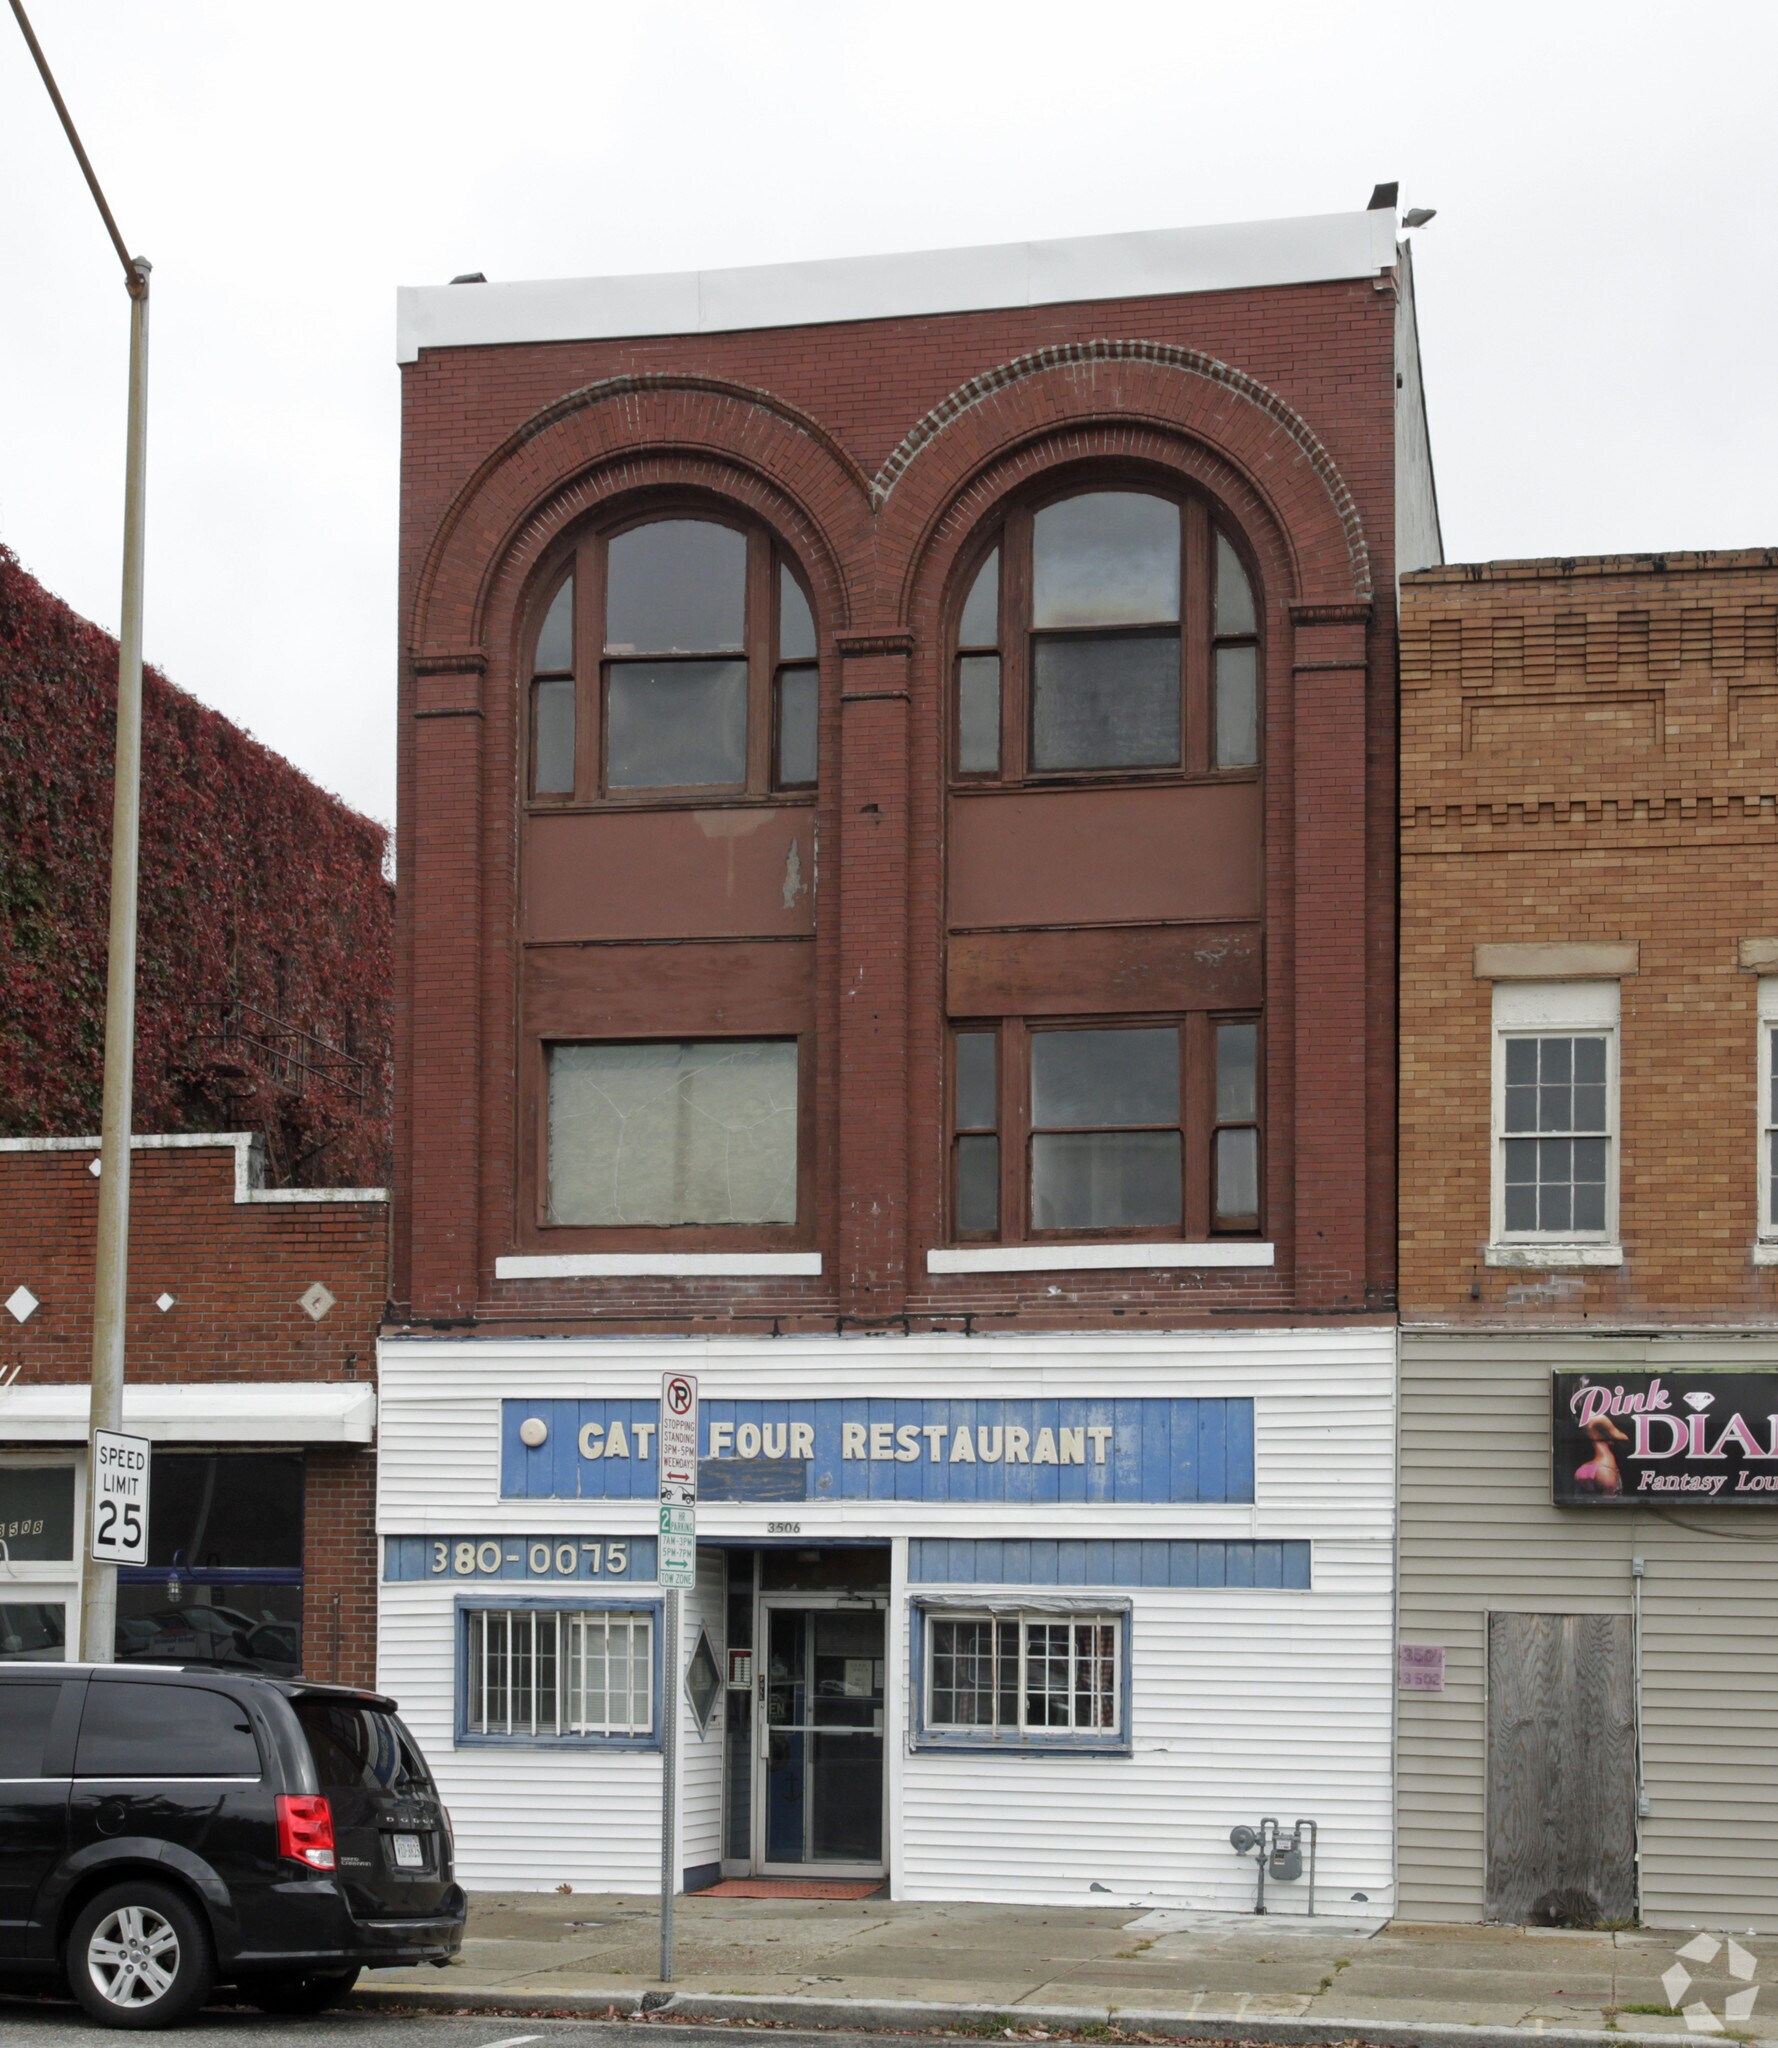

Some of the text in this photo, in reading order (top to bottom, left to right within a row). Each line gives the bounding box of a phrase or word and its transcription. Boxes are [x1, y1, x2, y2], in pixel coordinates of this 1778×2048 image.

[1570, 1378, 1672, 1427] Pink
[664, 1418, 695, 1431] STOPPING
[664, 1431, 695, 1444] STANDING
[1627, 1412, 1778, 1459] DIA
[578, 1421, 1113, 1465] GAT FOUR RESTAURANT
[664, 1444, 694, 1457] 3PM-5PM
[99, 1446, 145, 1470] SPEED
[664, 1456, 694, 1470] WEEKDAYS
[103, 1473, 139, 1496] LIMIT
[1637, 1470, 1728, 1495] Fantasy
[661, 1510, 670, 1530] 2
[678, 1511, 686, 1521] HR
[98, 1500, 142, 1548] 25
[671, 1521, 693, 1533] PARKING
[767, 1522, 801, 1534] 3506
[662, 1535, 692, 1547] 7AM-3PM
[432, 1541, 627, 1575] 380-0075
[662, 1547, 692, 1558] 5PM-7PM
[661, 1572, 692, 1585] TOW ZONE
